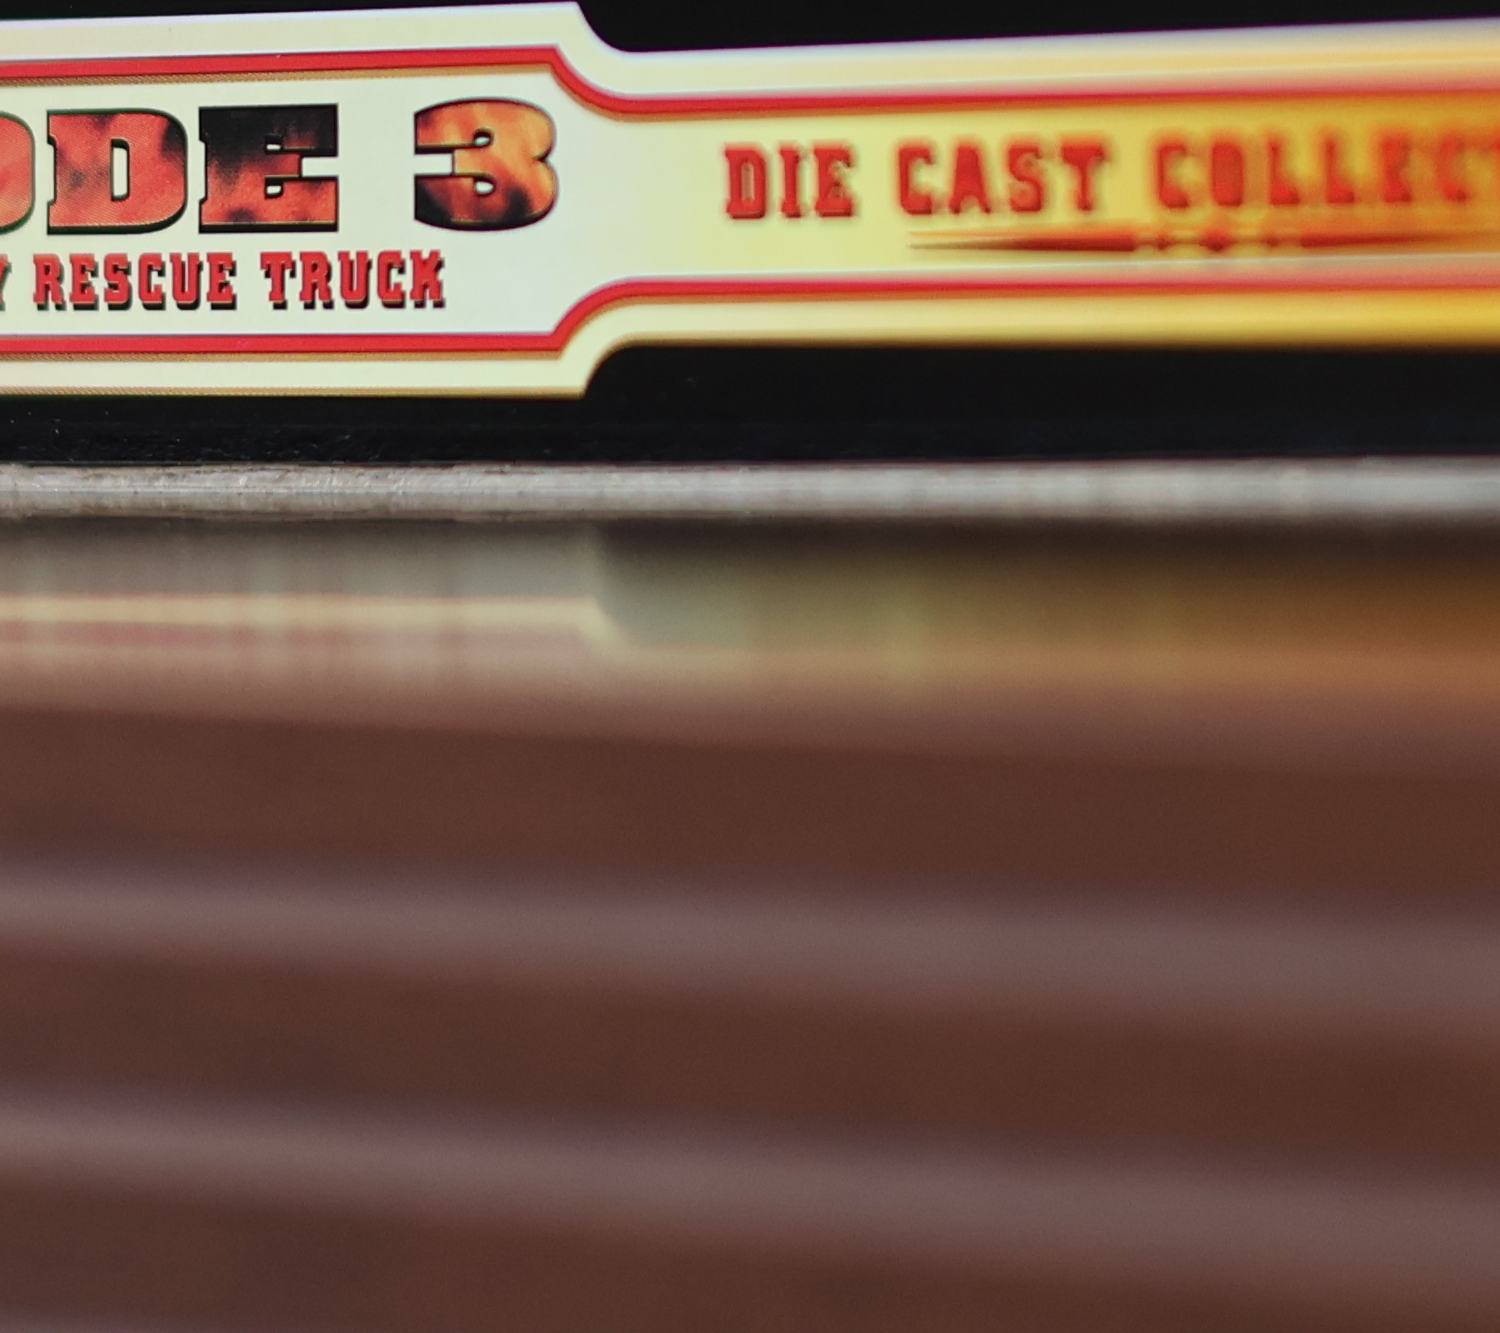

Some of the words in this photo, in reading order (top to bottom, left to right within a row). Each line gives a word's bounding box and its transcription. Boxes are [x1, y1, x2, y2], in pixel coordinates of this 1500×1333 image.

[414, 98, 559, 232] 3
[722, 142, 856, 219] DIE
[896, 139, 1112, 217] CAST
[32, 251, 239, 312] RESCUE
[260, 249, 447, 311] TRUCK
